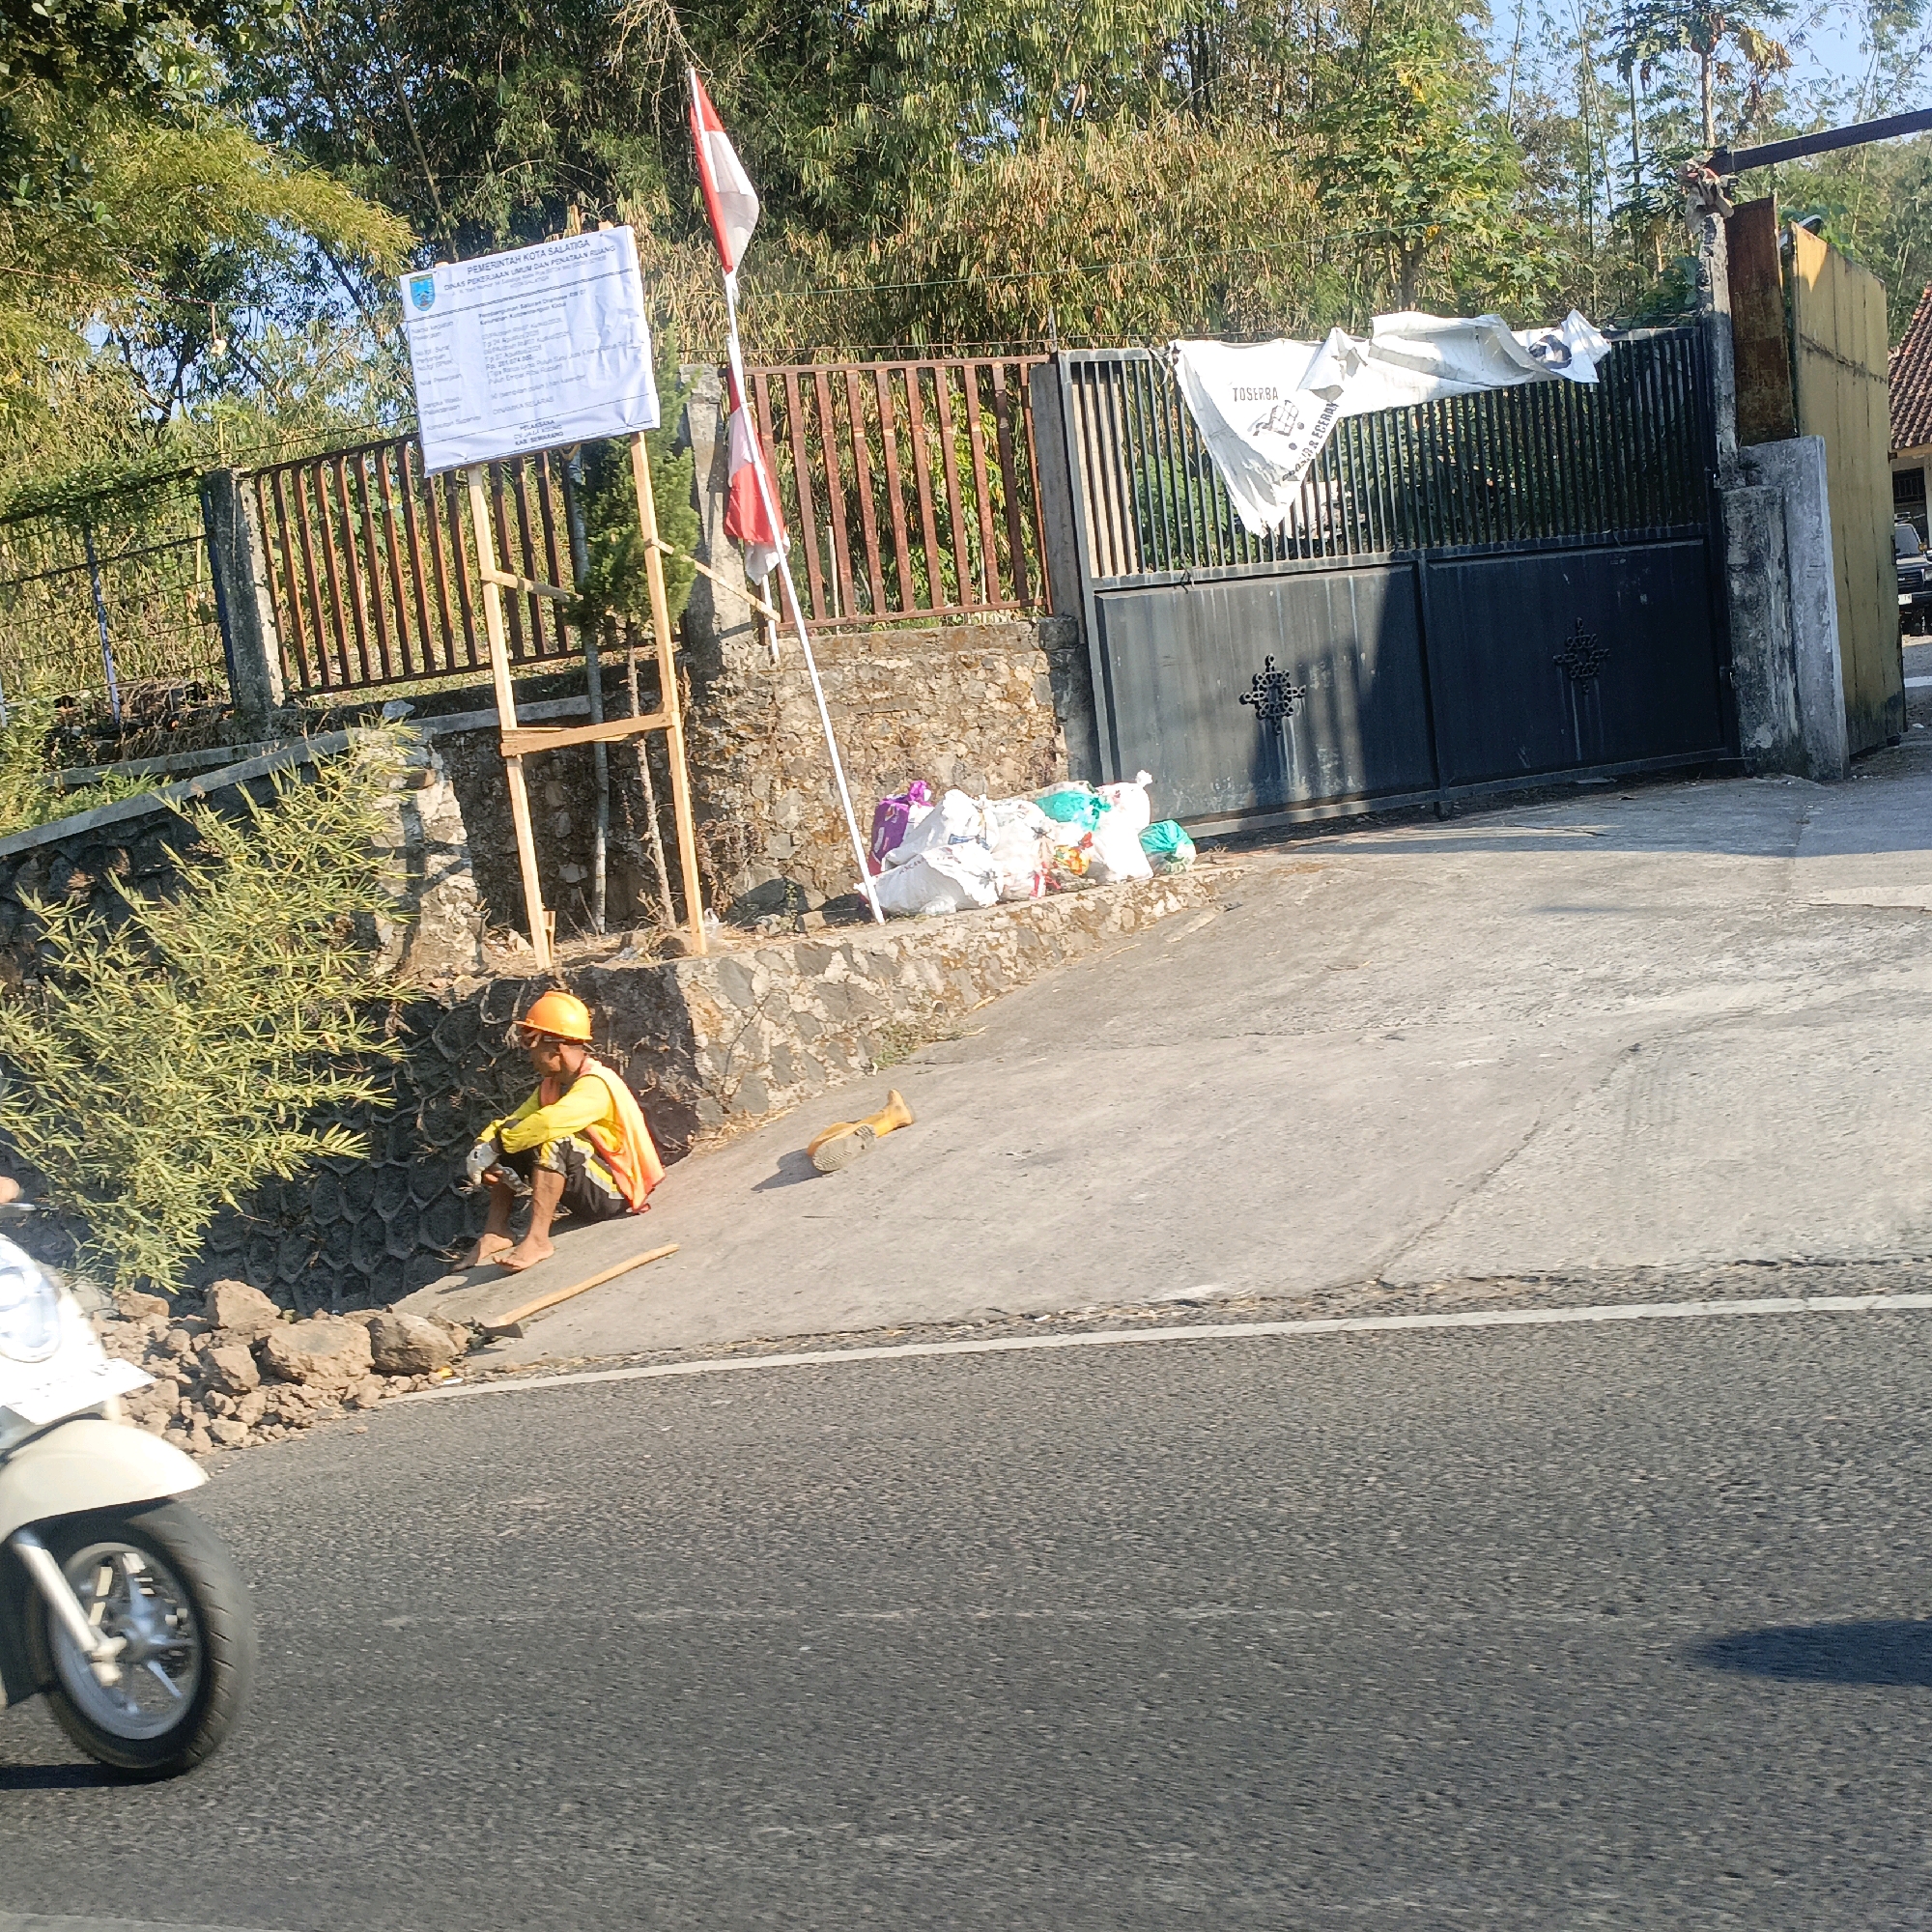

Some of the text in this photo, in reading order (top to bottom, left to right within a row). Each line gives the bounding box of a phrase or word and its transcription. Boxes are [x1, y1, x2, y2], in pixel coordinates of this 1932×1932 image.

[443, 280, 465, 290] DINAS
[533, 261, 549, 270] DAN
[589, 244, 615, 255] RUANG
[467, 239, 590, 274] PEMERINTAH KOTA SALATIGA
[1233, 387, 1279, 402] TOSERBA
[1311, 402, 1340, 440] ECERAN
